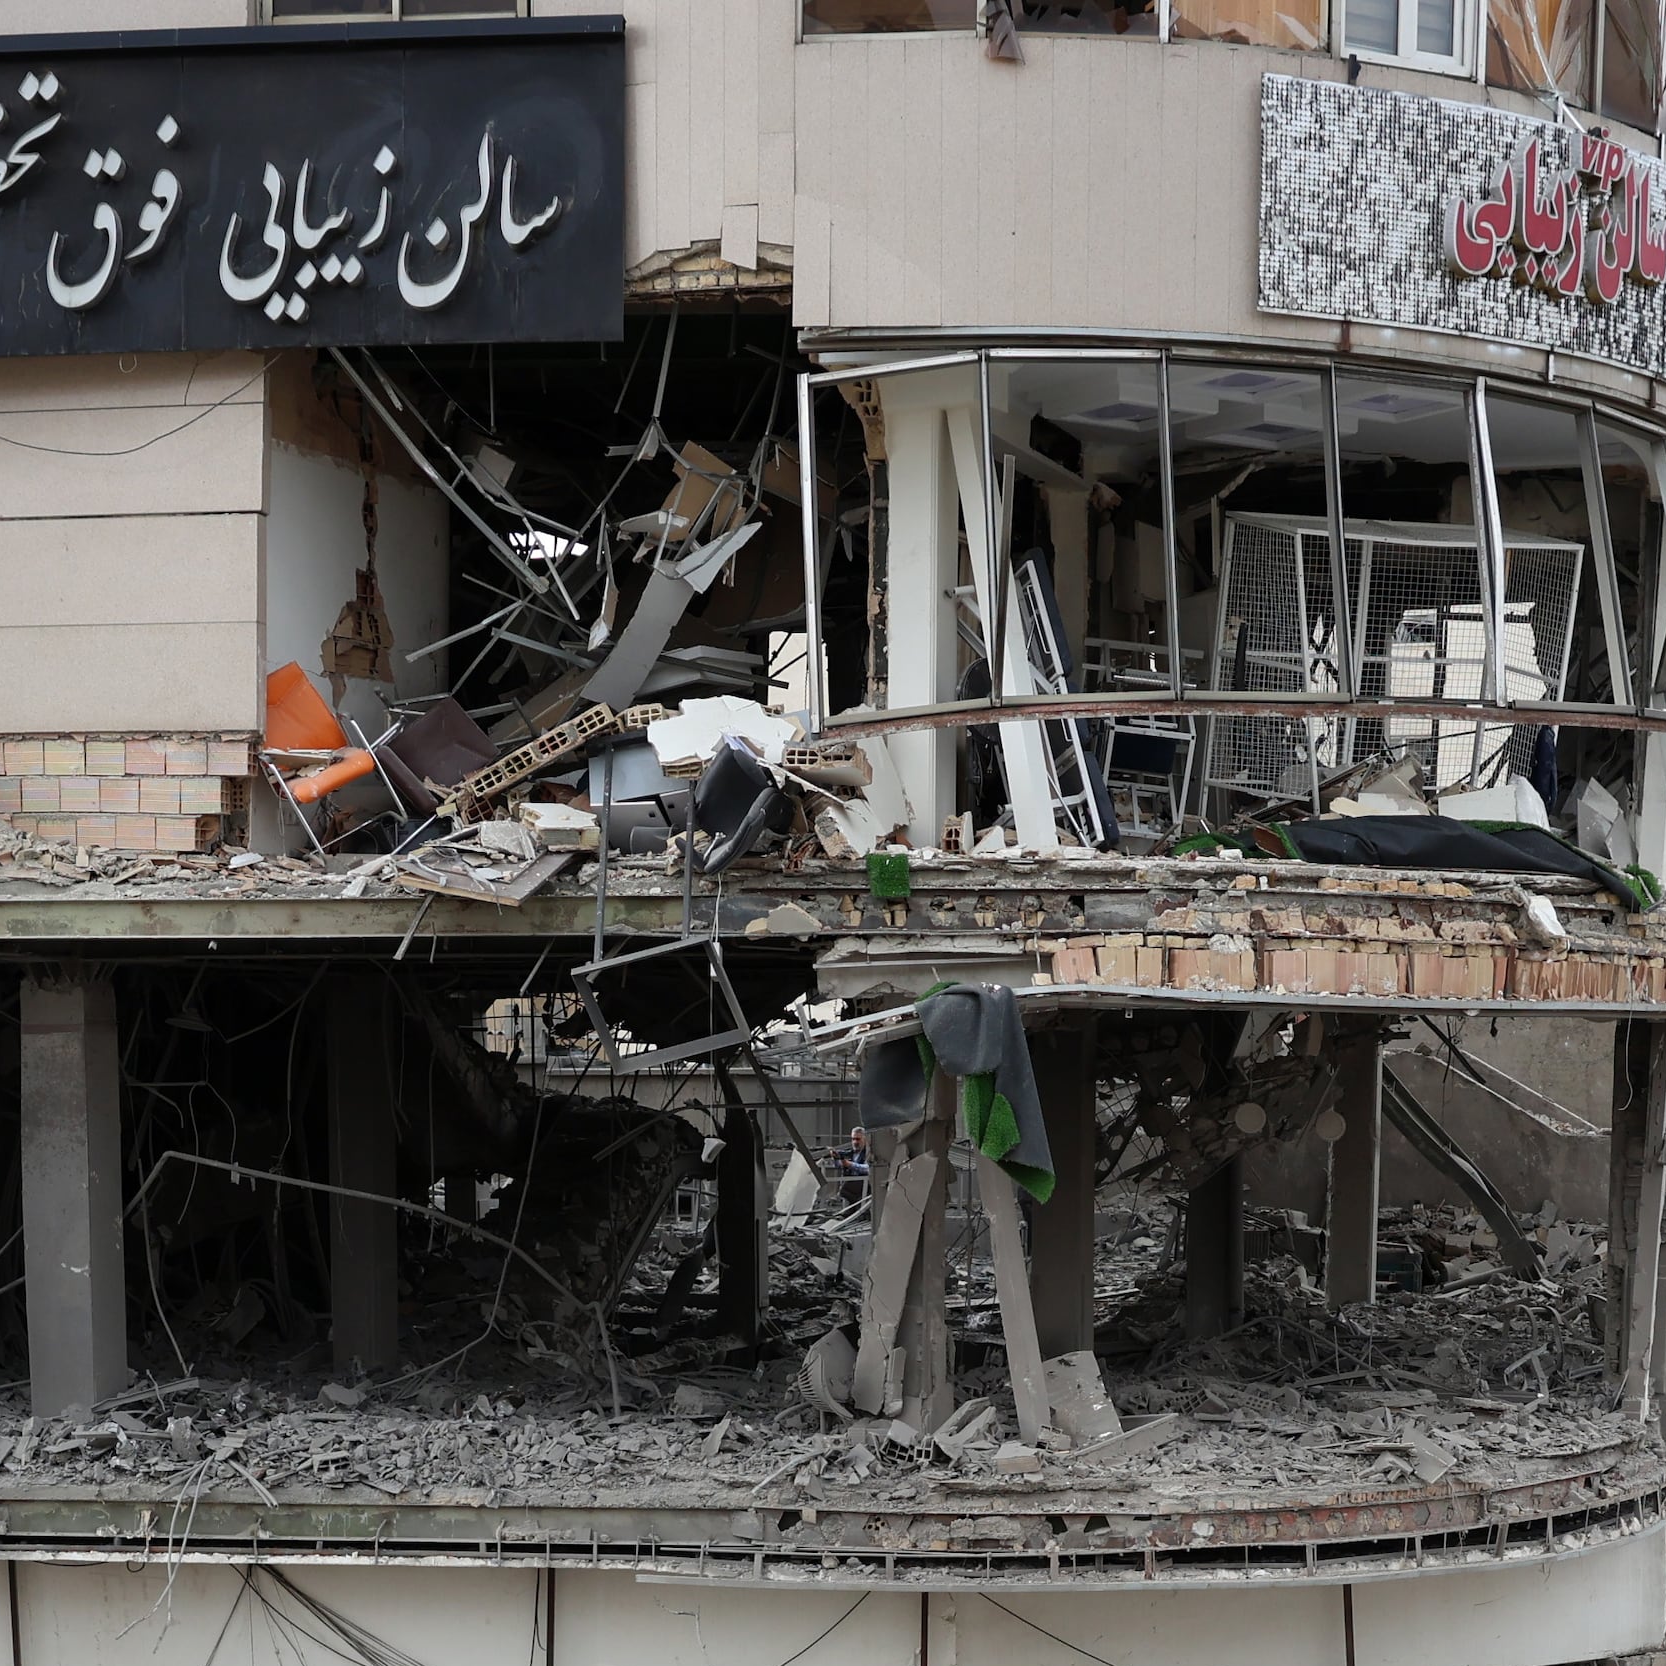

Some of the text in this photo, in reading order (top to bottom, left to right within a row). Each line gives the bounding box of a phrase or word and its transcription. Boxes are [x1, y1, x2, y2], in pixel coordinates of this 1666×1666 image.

[46, 113, 183, 310] فوق
[219, 145, 398, 323] زیبایی
[397, 131, 559, 311] سالن
[1454, 135, 1583, 296] زیبایی
[1582, 127, 1626, 193] vip
